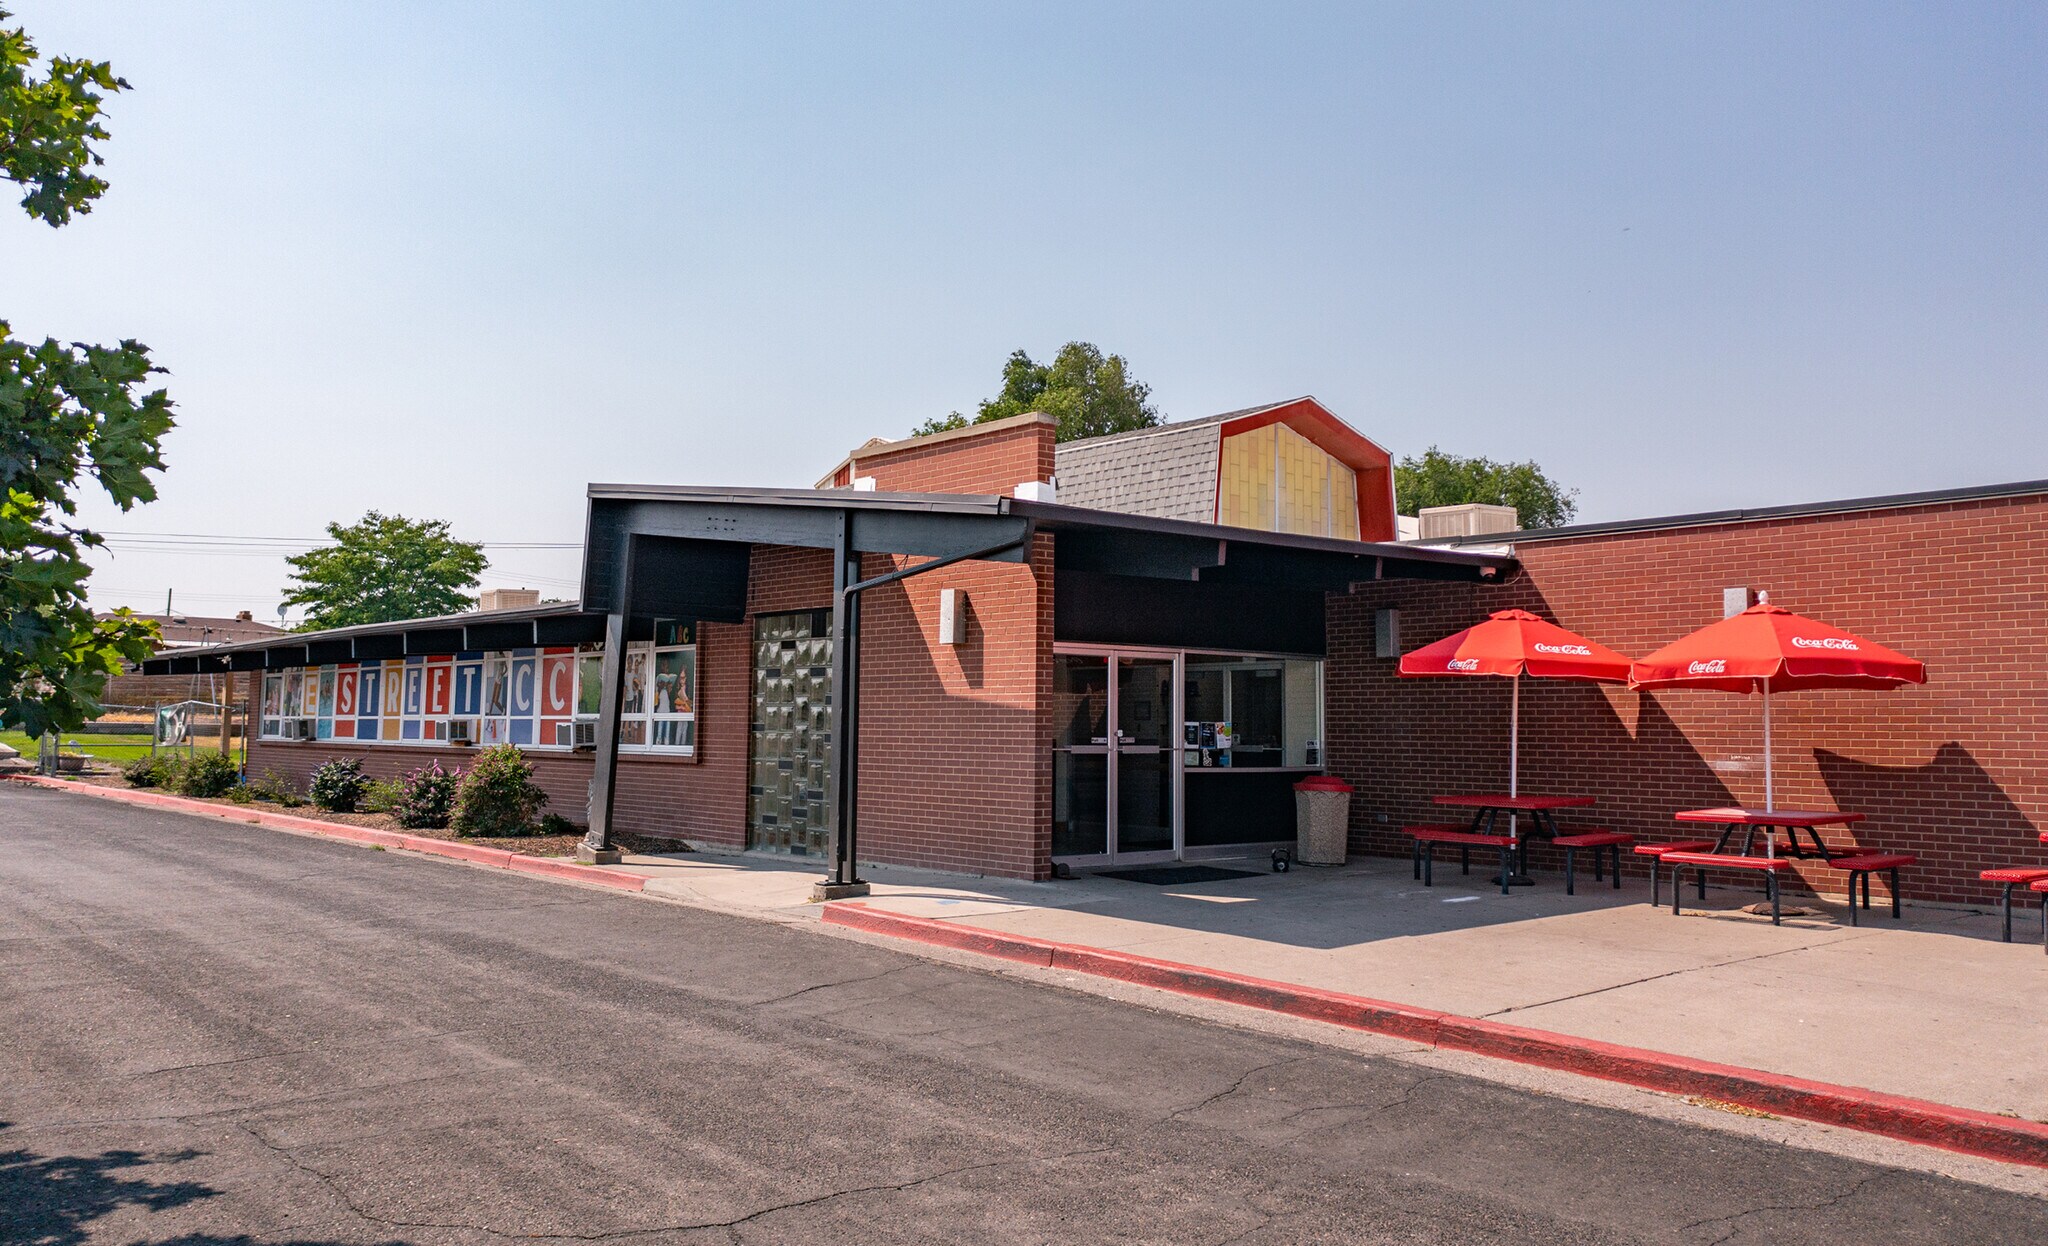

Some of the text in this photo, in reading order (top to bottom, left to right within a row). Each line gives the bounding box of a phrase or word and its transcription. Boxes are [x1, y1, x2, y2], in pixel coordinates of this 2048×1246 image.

[669, 625, 689, 644] ABC
[306, 679, 317, 713] E
[341, 667, 476, 713] STREET
